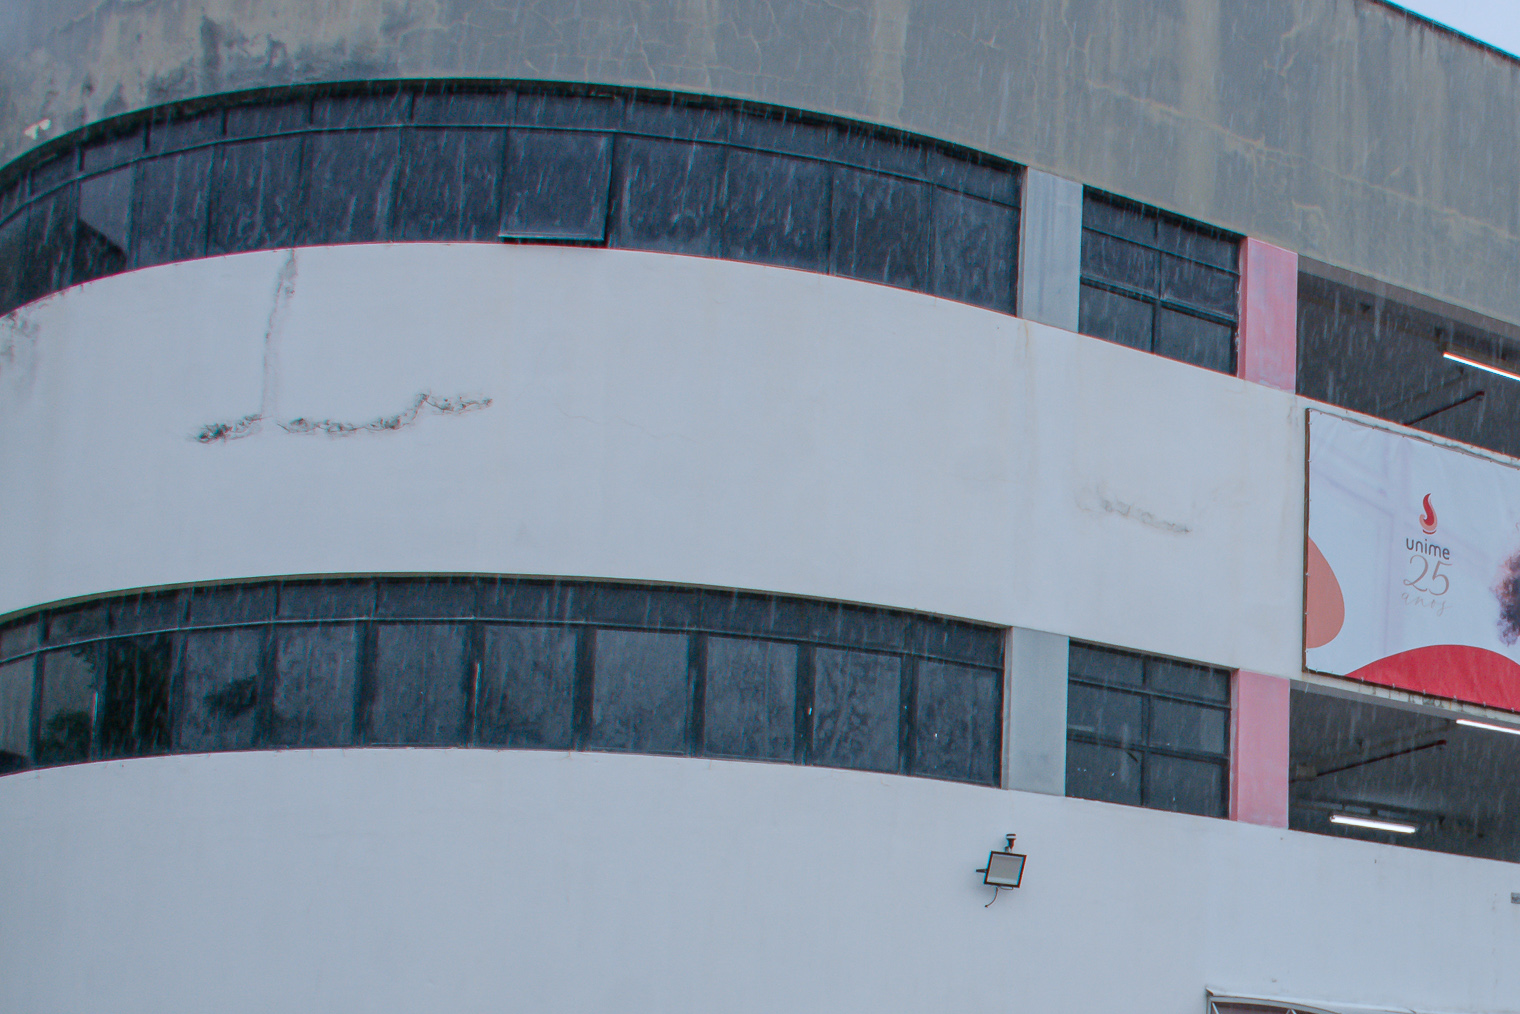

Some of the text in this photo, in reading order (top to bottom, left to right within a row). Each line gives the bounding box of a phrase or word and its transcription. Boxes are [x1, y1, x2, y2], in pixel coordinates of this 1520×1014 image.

[1405, 537, 1451, 561] unime
[1403, 554, 1453, 596] 25
[1401, 591, 1453, 617] anos
